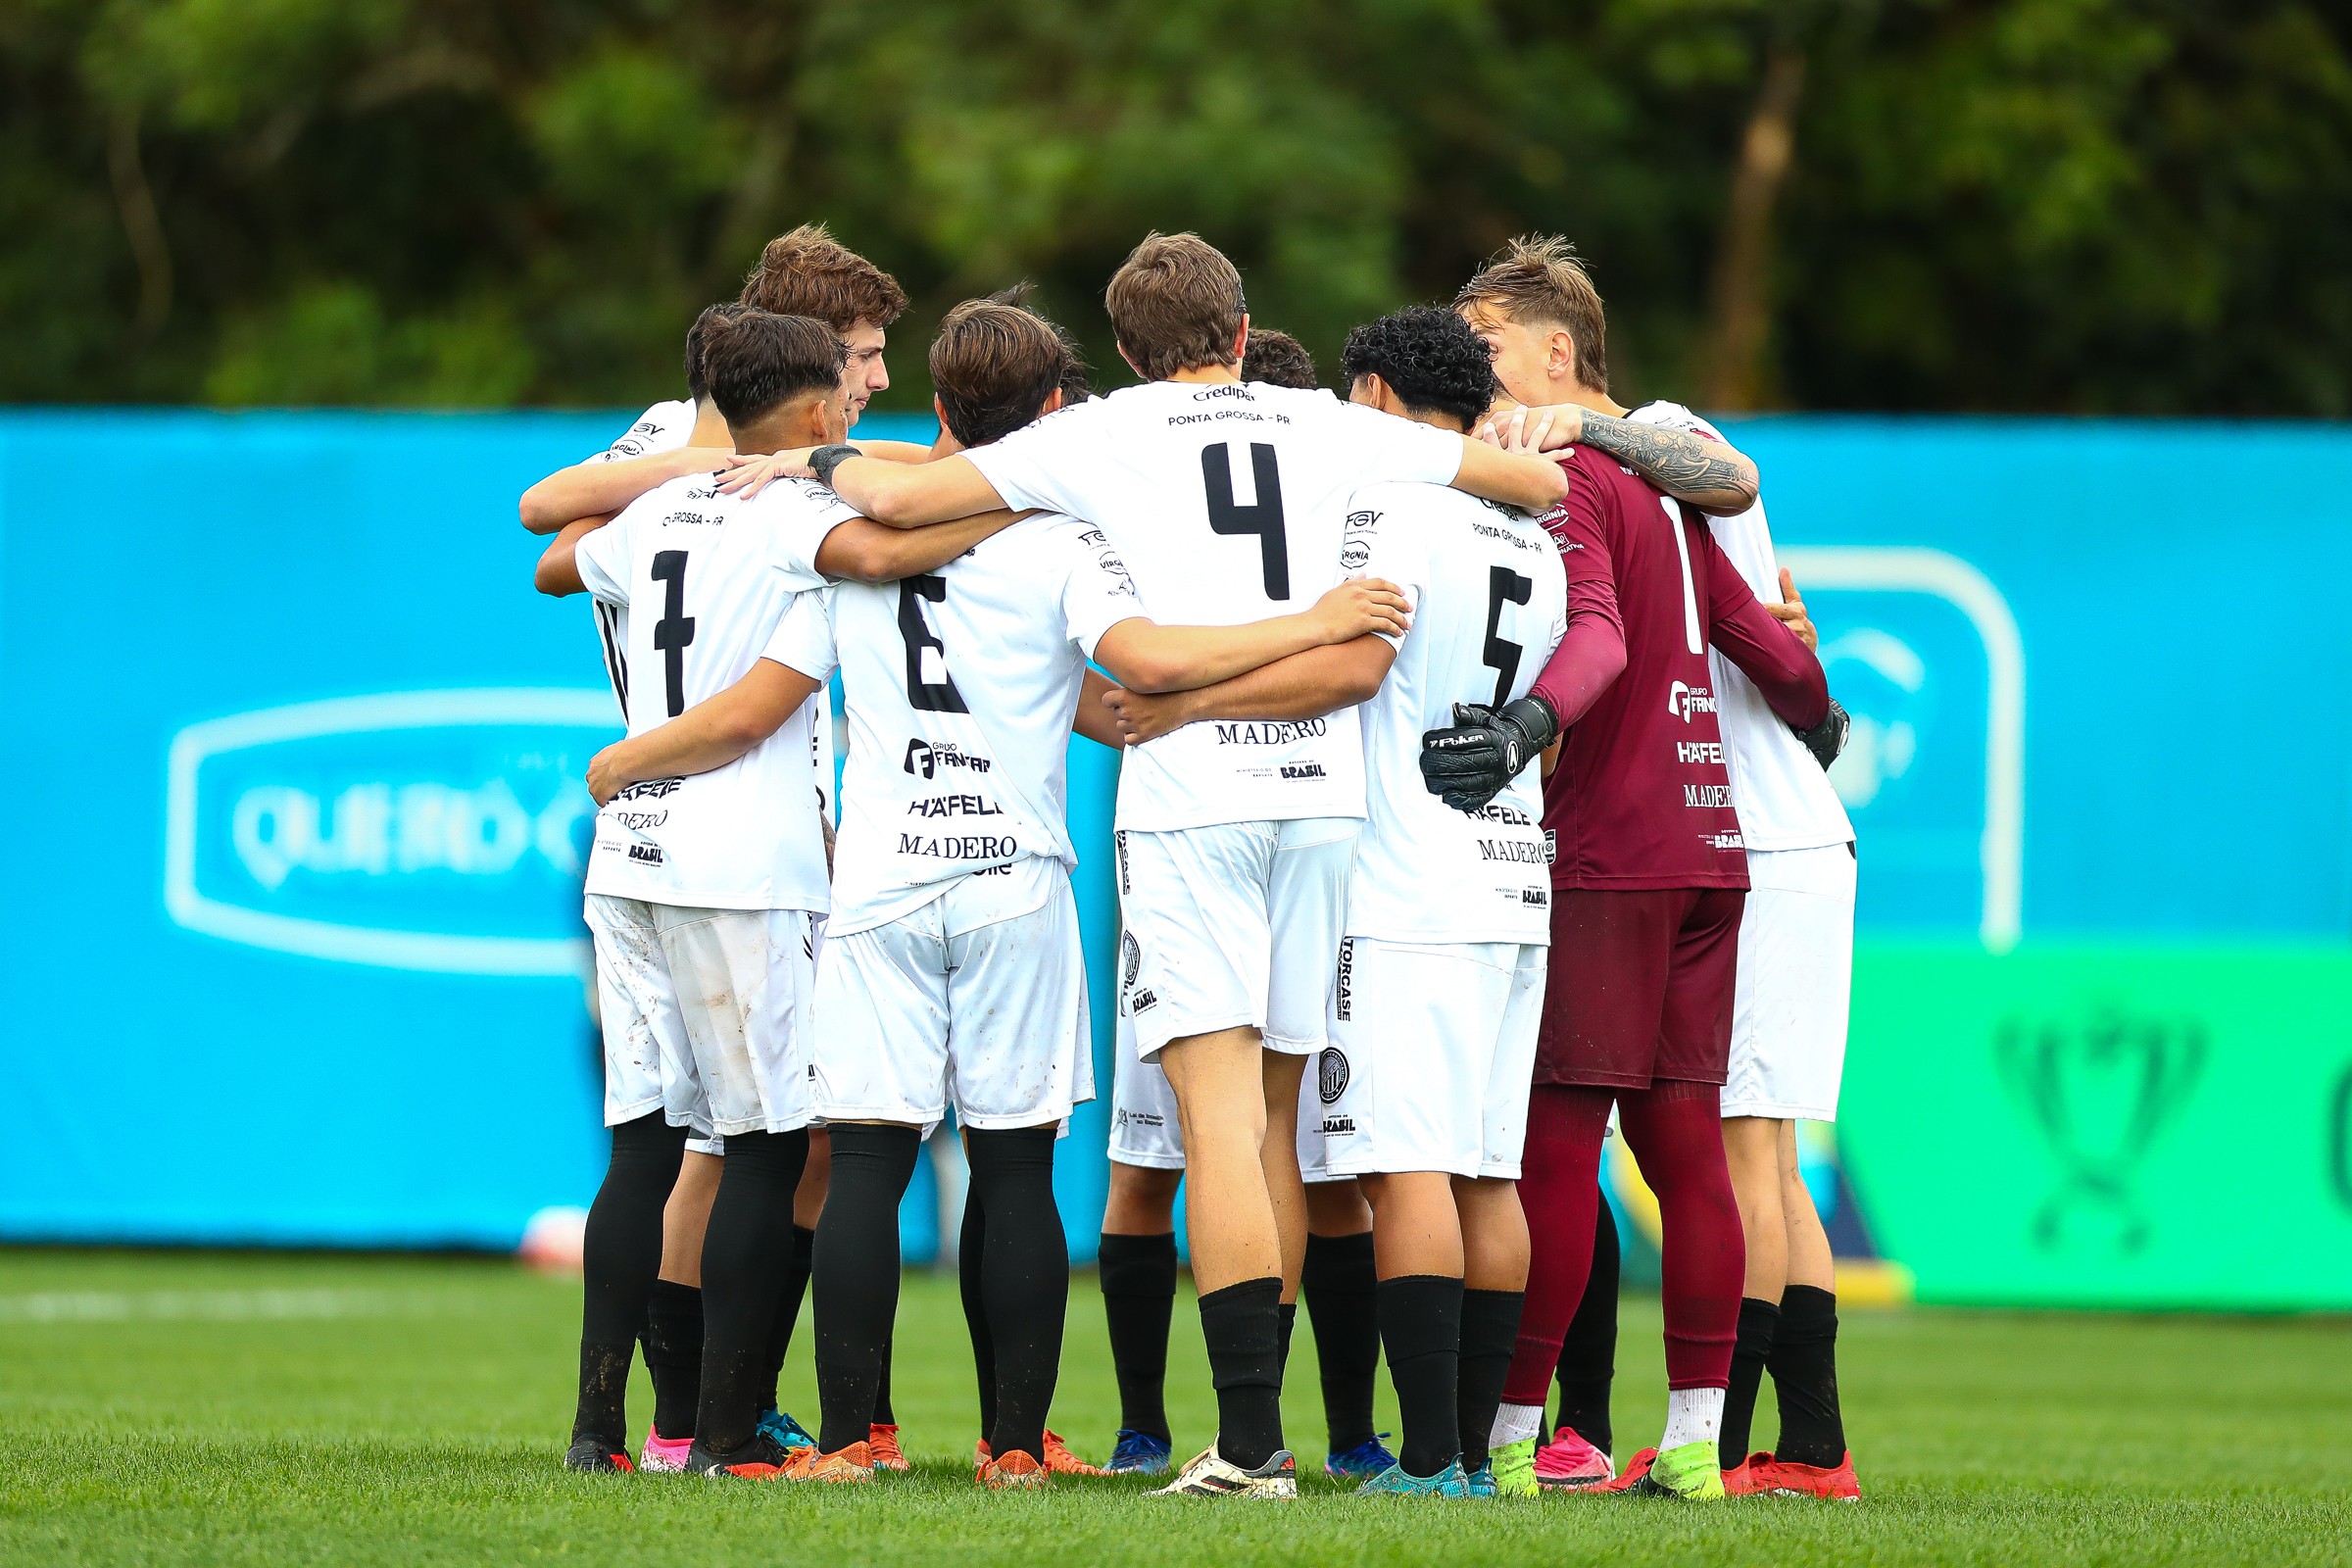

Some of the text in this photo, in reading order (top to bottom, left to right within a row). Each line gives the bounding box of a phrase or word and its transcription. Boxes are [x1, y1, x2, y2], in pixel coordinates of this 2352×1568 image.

[1168, 414, 1212, 426] PONTA
[1215, 411, 1264, 421] GROSSA
[1276, 414, 1292, 425] PR
[1201, 442, 1290, 601] 4
[1345, 511, 1384, 527] FGV
[1537, 509, 1569, 524] RGINIA
[1472, 522, 1501, 539] PONTA
[1660, 495, 1703, 656] 1
[899, 576, 971, 713] 6
[1483, 565, 1533, 710] 5
[1690, 687, 1708, 696] GRUPO
[1214, 718, 1327, 745] MADERO
[1677, 741, 1727, 764] HÄFEL
[1280, 764, 1326, 779] BRASIL
[907, 795, 1004, 818] HÄFEL
[628, 845, 663, 863] BRASIL
[898, 833, 1017, 859] MADERO
[1522, 890, 1547, 905] BRASIL
[1341, 936, 1354, 1022] TORCASE
[1322, 1119, 1355, 1133] BRASIL
